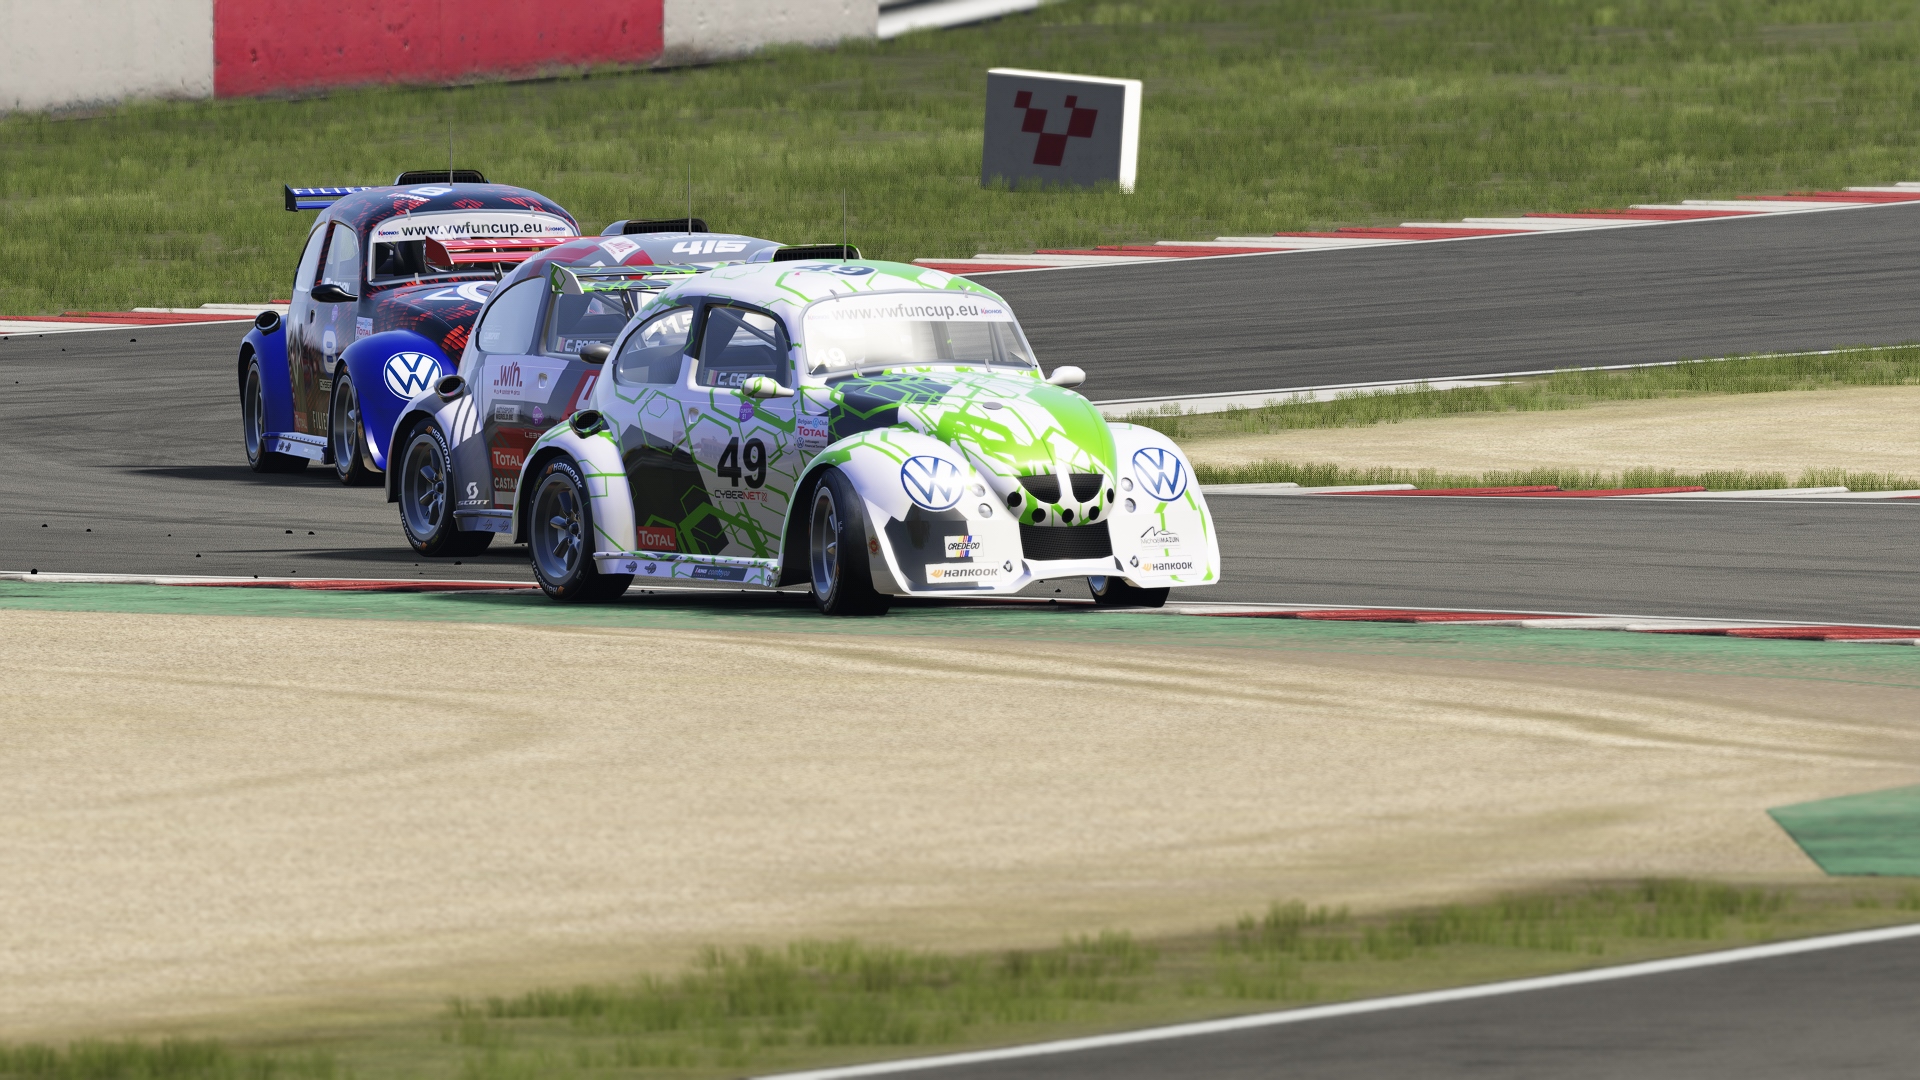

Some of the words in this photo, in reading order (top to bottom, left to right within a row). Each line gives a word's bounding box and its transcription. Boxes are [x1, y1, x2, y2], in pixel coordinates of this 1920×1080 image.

[401, 221, 542, 237] www.vwfuncup.eu
[672, 240, 752, 256] 415
[795, 264, 876, 276] 49
[832, 303, 978, 321] www.vwfuncup.eu
[312, 410, 328, 431] FILIE
[797, 425, 828, 438] TOTAL
[493, 451, 524, 467] TOTAL
[717, 436, 767, 489] 49
[639, 530, 675, 547] TOTAL
[947, 542, 980, 551] CREDECO
